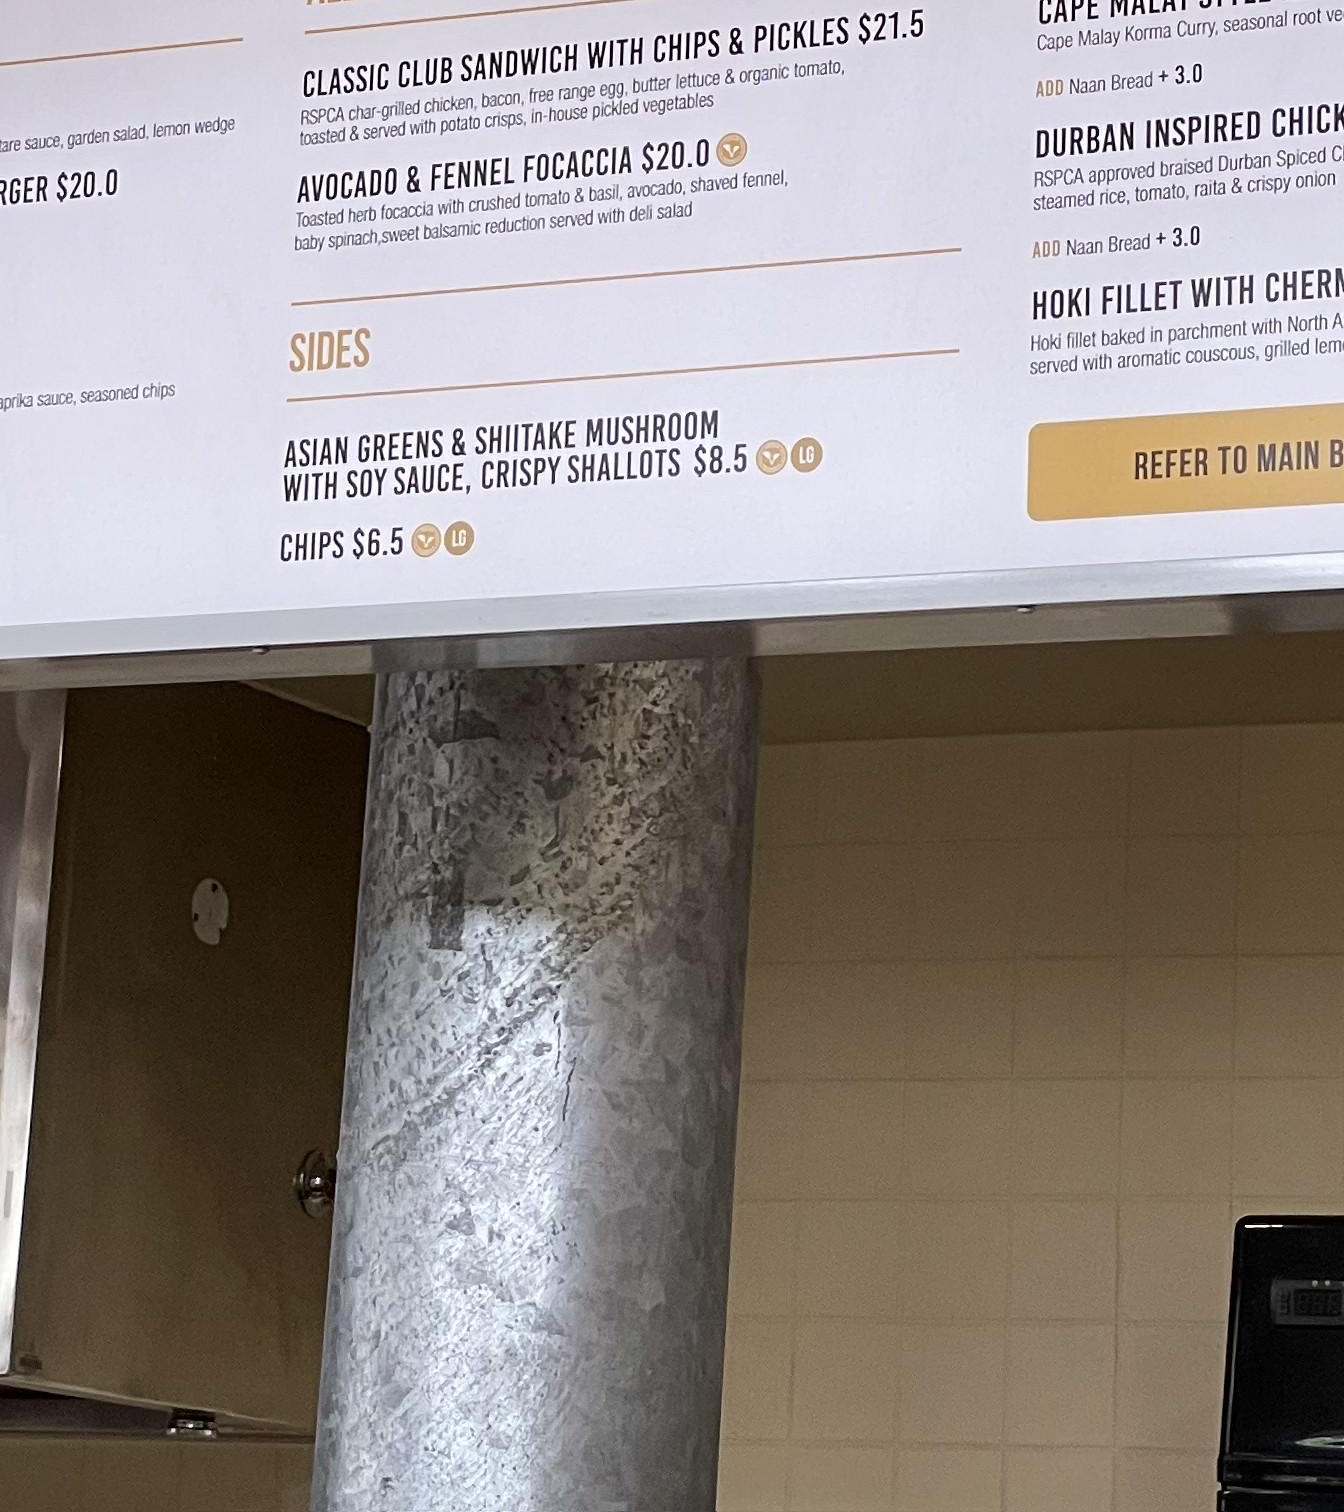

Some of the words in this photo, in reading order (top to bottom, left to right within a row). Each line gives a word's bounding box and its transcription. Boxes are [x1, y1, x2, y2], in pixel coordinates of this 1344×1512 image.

[303, 62, 390, 98] CLASSIC
[398, 56, 453, 88] CLUB
[460, 43, 578, 82] SANDWICH
[587, 36, 644, 70] WITH
[653, 29, 720, 63] CHIPS
[728, 27, 745, 56] &
[754, 16, 850, 54] PICKLES
[858, 8, 924, 46] $21.5
[1035, 79, 1064, 98] ADD
[1069, 78, 1106, 95] Naan
[1111, 70, 1153, 92] Bread
[1174, 63, 1203, 85] 3.0
[1035, 121, 1135, 159] DURBAN
[1146, 110, 1261, 149] INSPIRED
[56, 168, 118, 203] $20.0
[296, 167, 398, 204] AVOCADO
[406, 165, 422, 194] &
[430, 156, 516, 192] FENNEL
[523, 145, 632, 184] FOCACCIA
[641, 138, 710, 175] $20.0
[1032, 286, 1091, 320] HOKI
[1101, 279, 1183, 316] FILLET
[1190, 274, 1254, 308] WITH
[288, 327, 371, 373] SIDES
[1030, 332, 1062, 352] Hoki
[1066, 330, 1097, 350] fillet
[1101, 326, 1146, 347] baked
[1150, 326, 1163, 343] in
[1167, 320, 1248, 346] parchment
[1251, 316, 1282, 336] with
[1287, 313, 1328, 334] North
[283, 436, 349, 468] ASIAN
[357, 429, 444, 464] GREENS
[451, 428, 467, 456] &
[474, 419, 577, 456] SHIITAKE
[585, 409, 719, 448] MUSHROOM
[1134, 447, 1209, 480] REFER
[1217, 444, 1248, 476] TO
[1257, 440, 1320, 473] MAIN
[283, 470, 338, 502] WITH
[346, 467, 388, 498] SOY
[393, 462, 471, 496] SAUCE,
[481, 455, 562, 490] CRISPY
[567, 447, 681, 484] SHALLOTS
[693, 443, 747, 478] $8.5
[280, 530, 344, 562] CHIPS
[352, 526, 404, 560] $6.5
